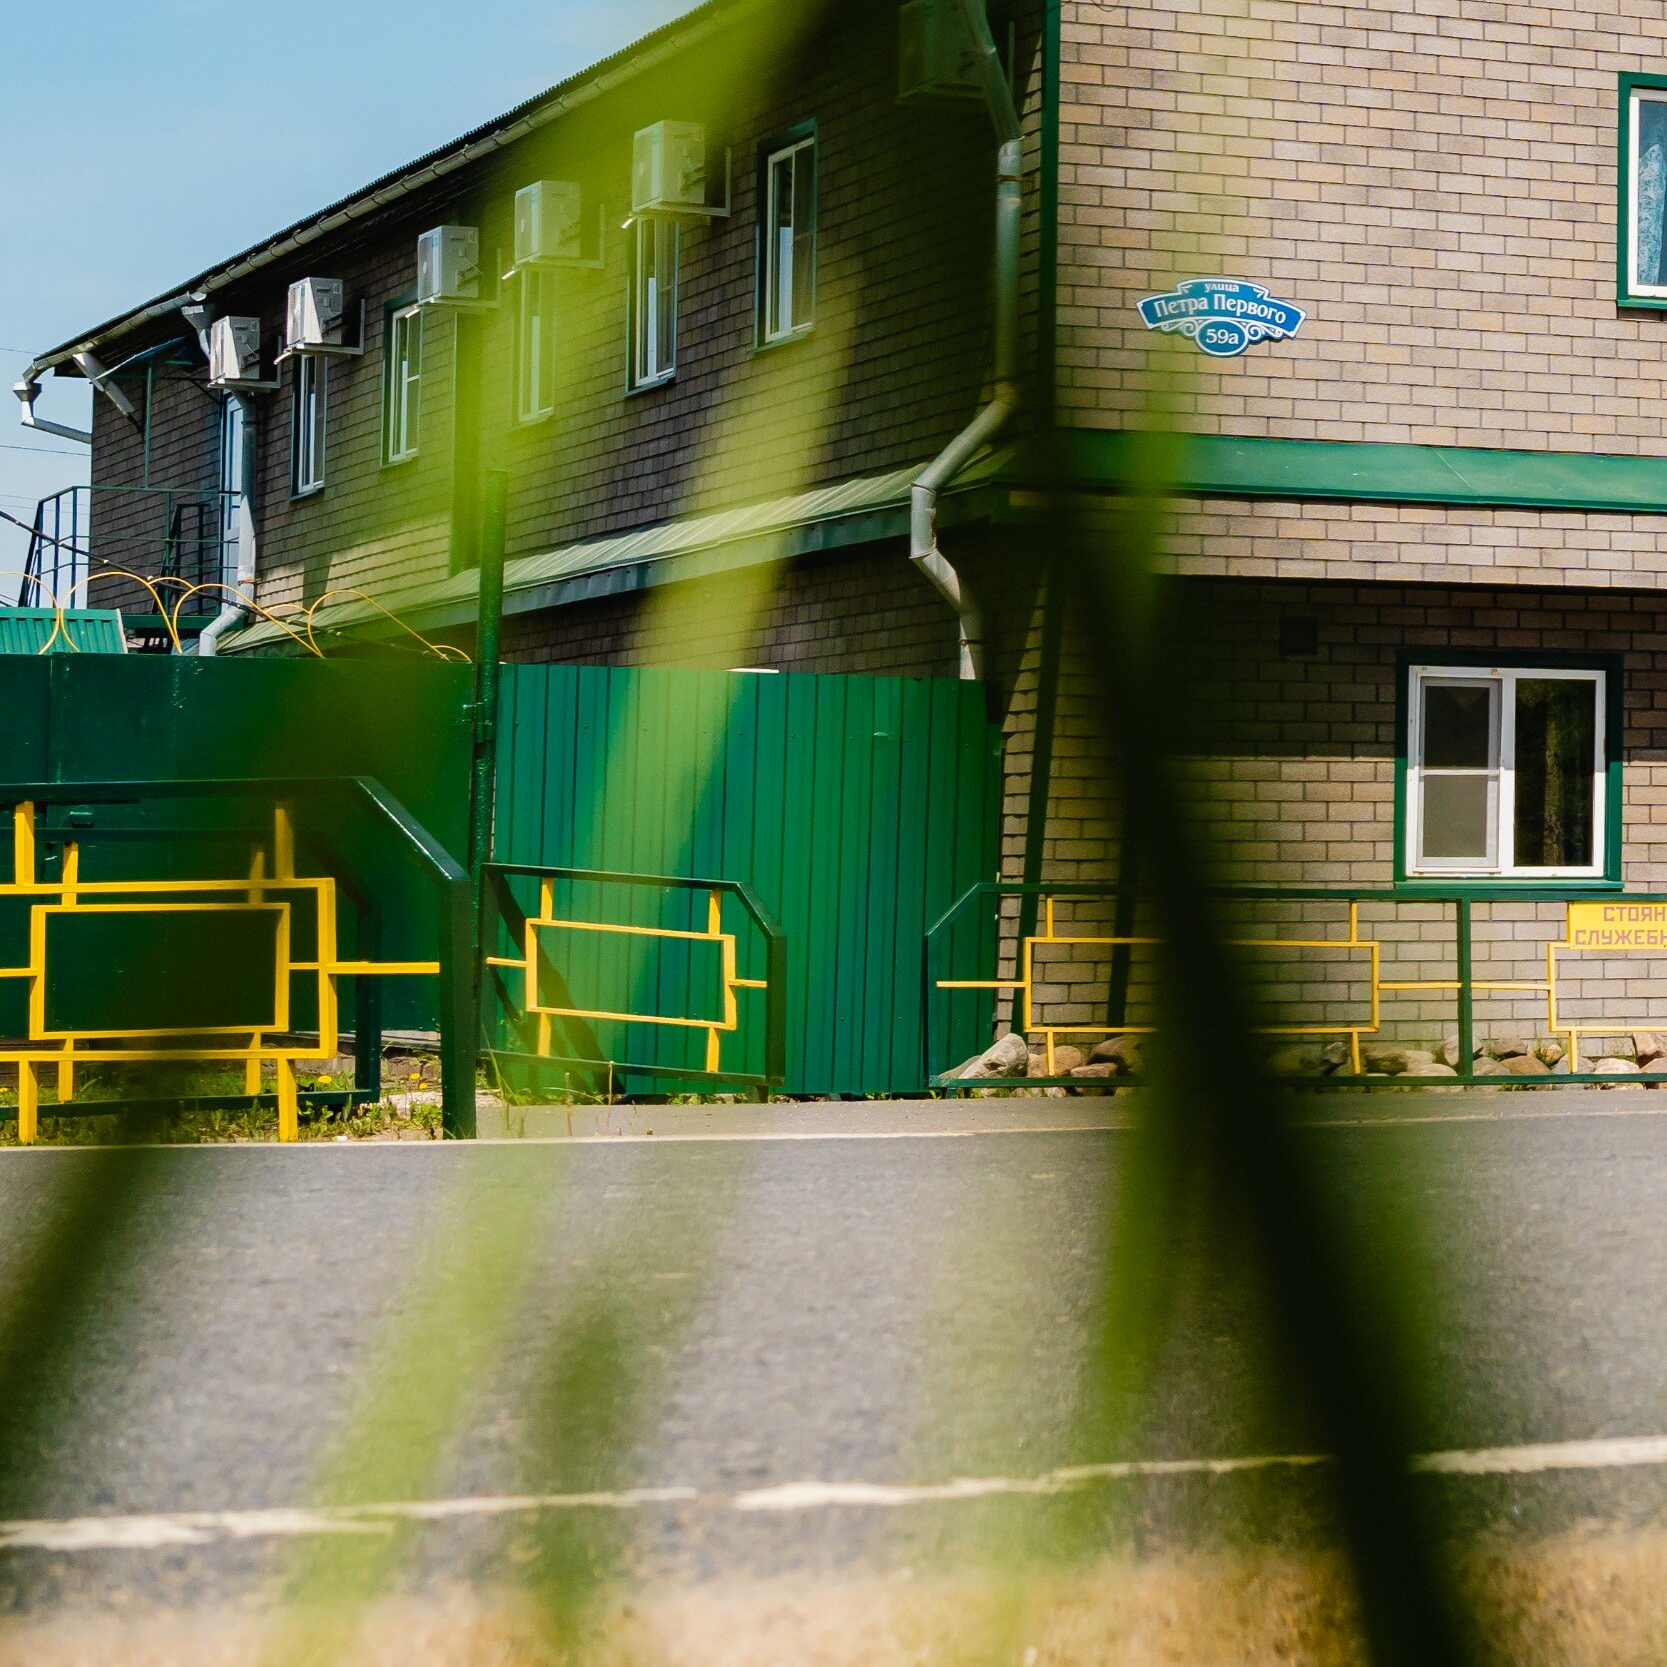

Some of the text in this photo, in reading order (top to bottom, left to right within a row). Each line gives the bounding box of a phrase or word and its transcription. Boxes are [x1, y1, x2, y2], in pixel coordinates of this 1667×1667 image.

[1204, 282, 1239, 293] улица
[1153, 293, 1287, 325] Петра Первого
[1205, 328, 1239, 345] 59а
